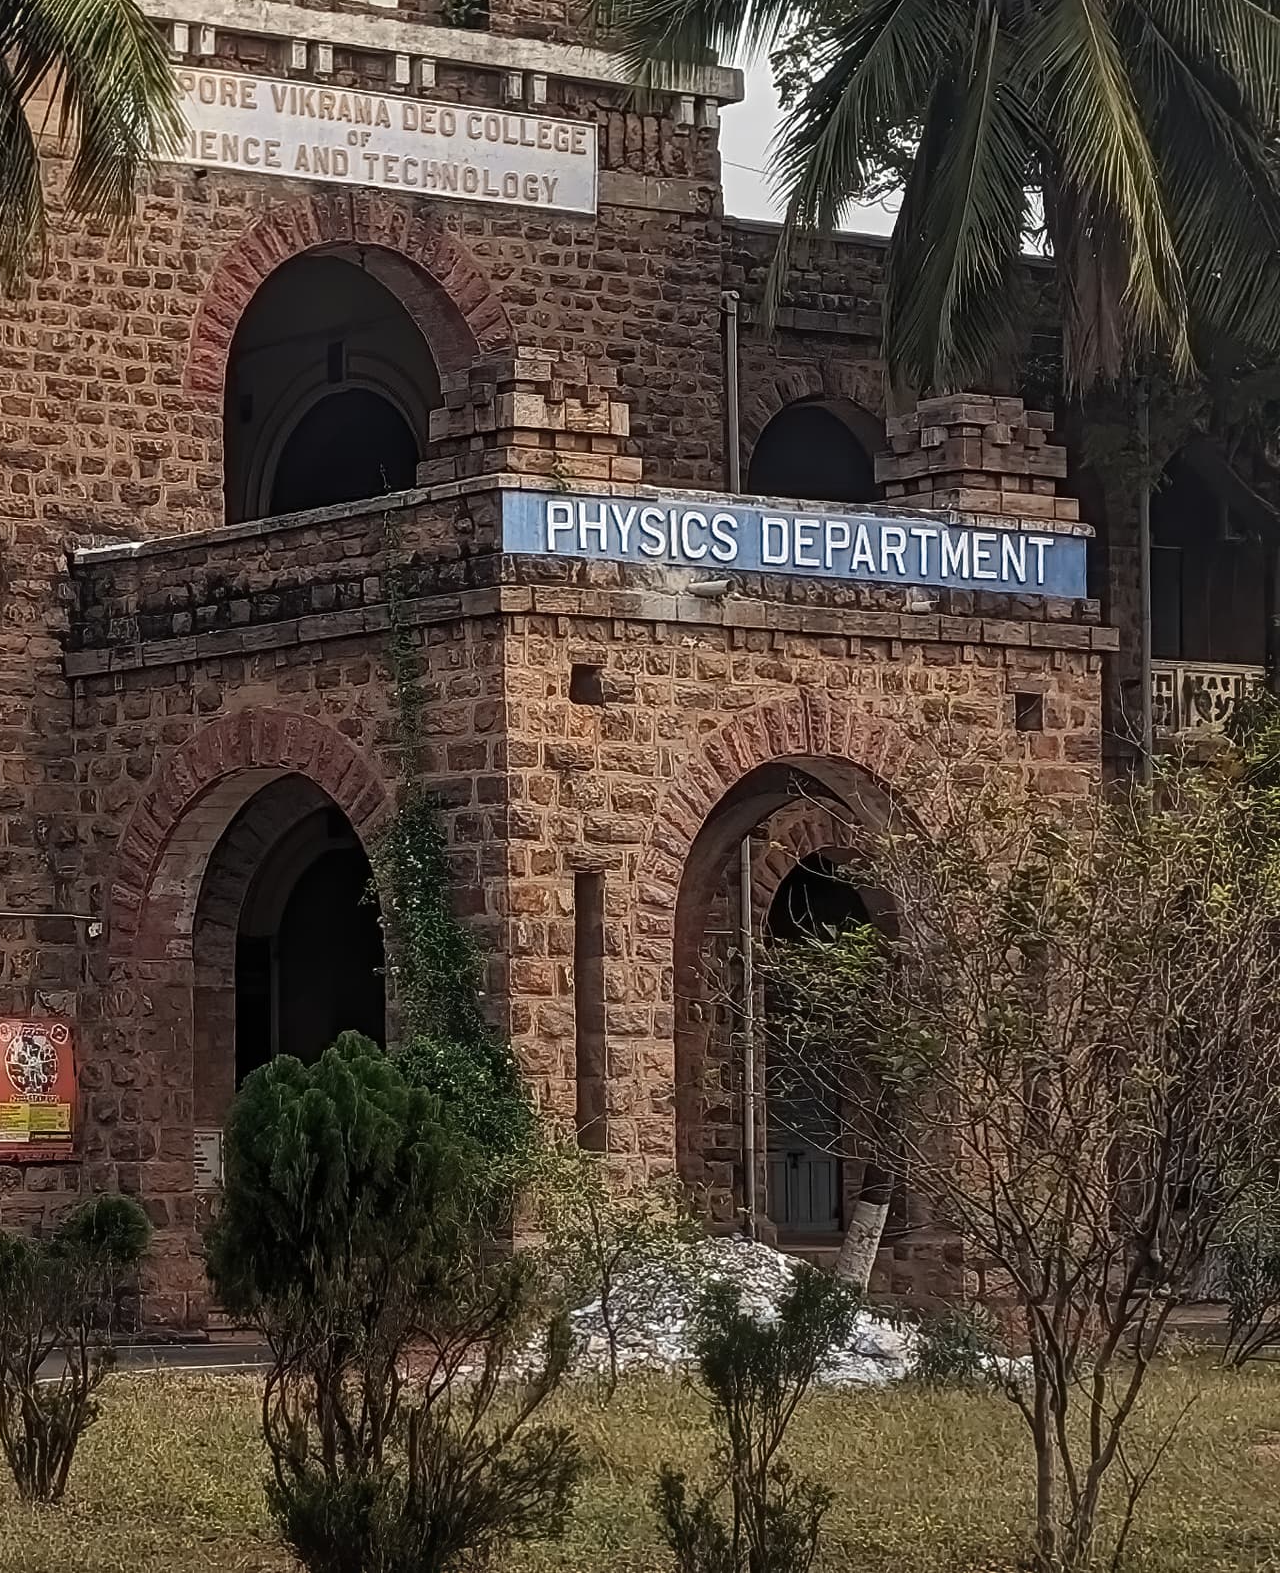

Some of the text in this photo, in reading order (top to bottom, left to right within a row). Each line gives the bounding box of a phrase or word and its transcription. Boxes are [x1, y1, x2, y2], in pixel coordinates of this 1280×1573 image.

[177, 71, 588, 156] PORE VIKRAMA DEO COLLEGE
[346, 128, 372, 149] OF
[190, 129, 560, 204] IENCE AND TECHNOLOGY
[545, 499, 1055, 586] PHYSICS DEPARTMENT
